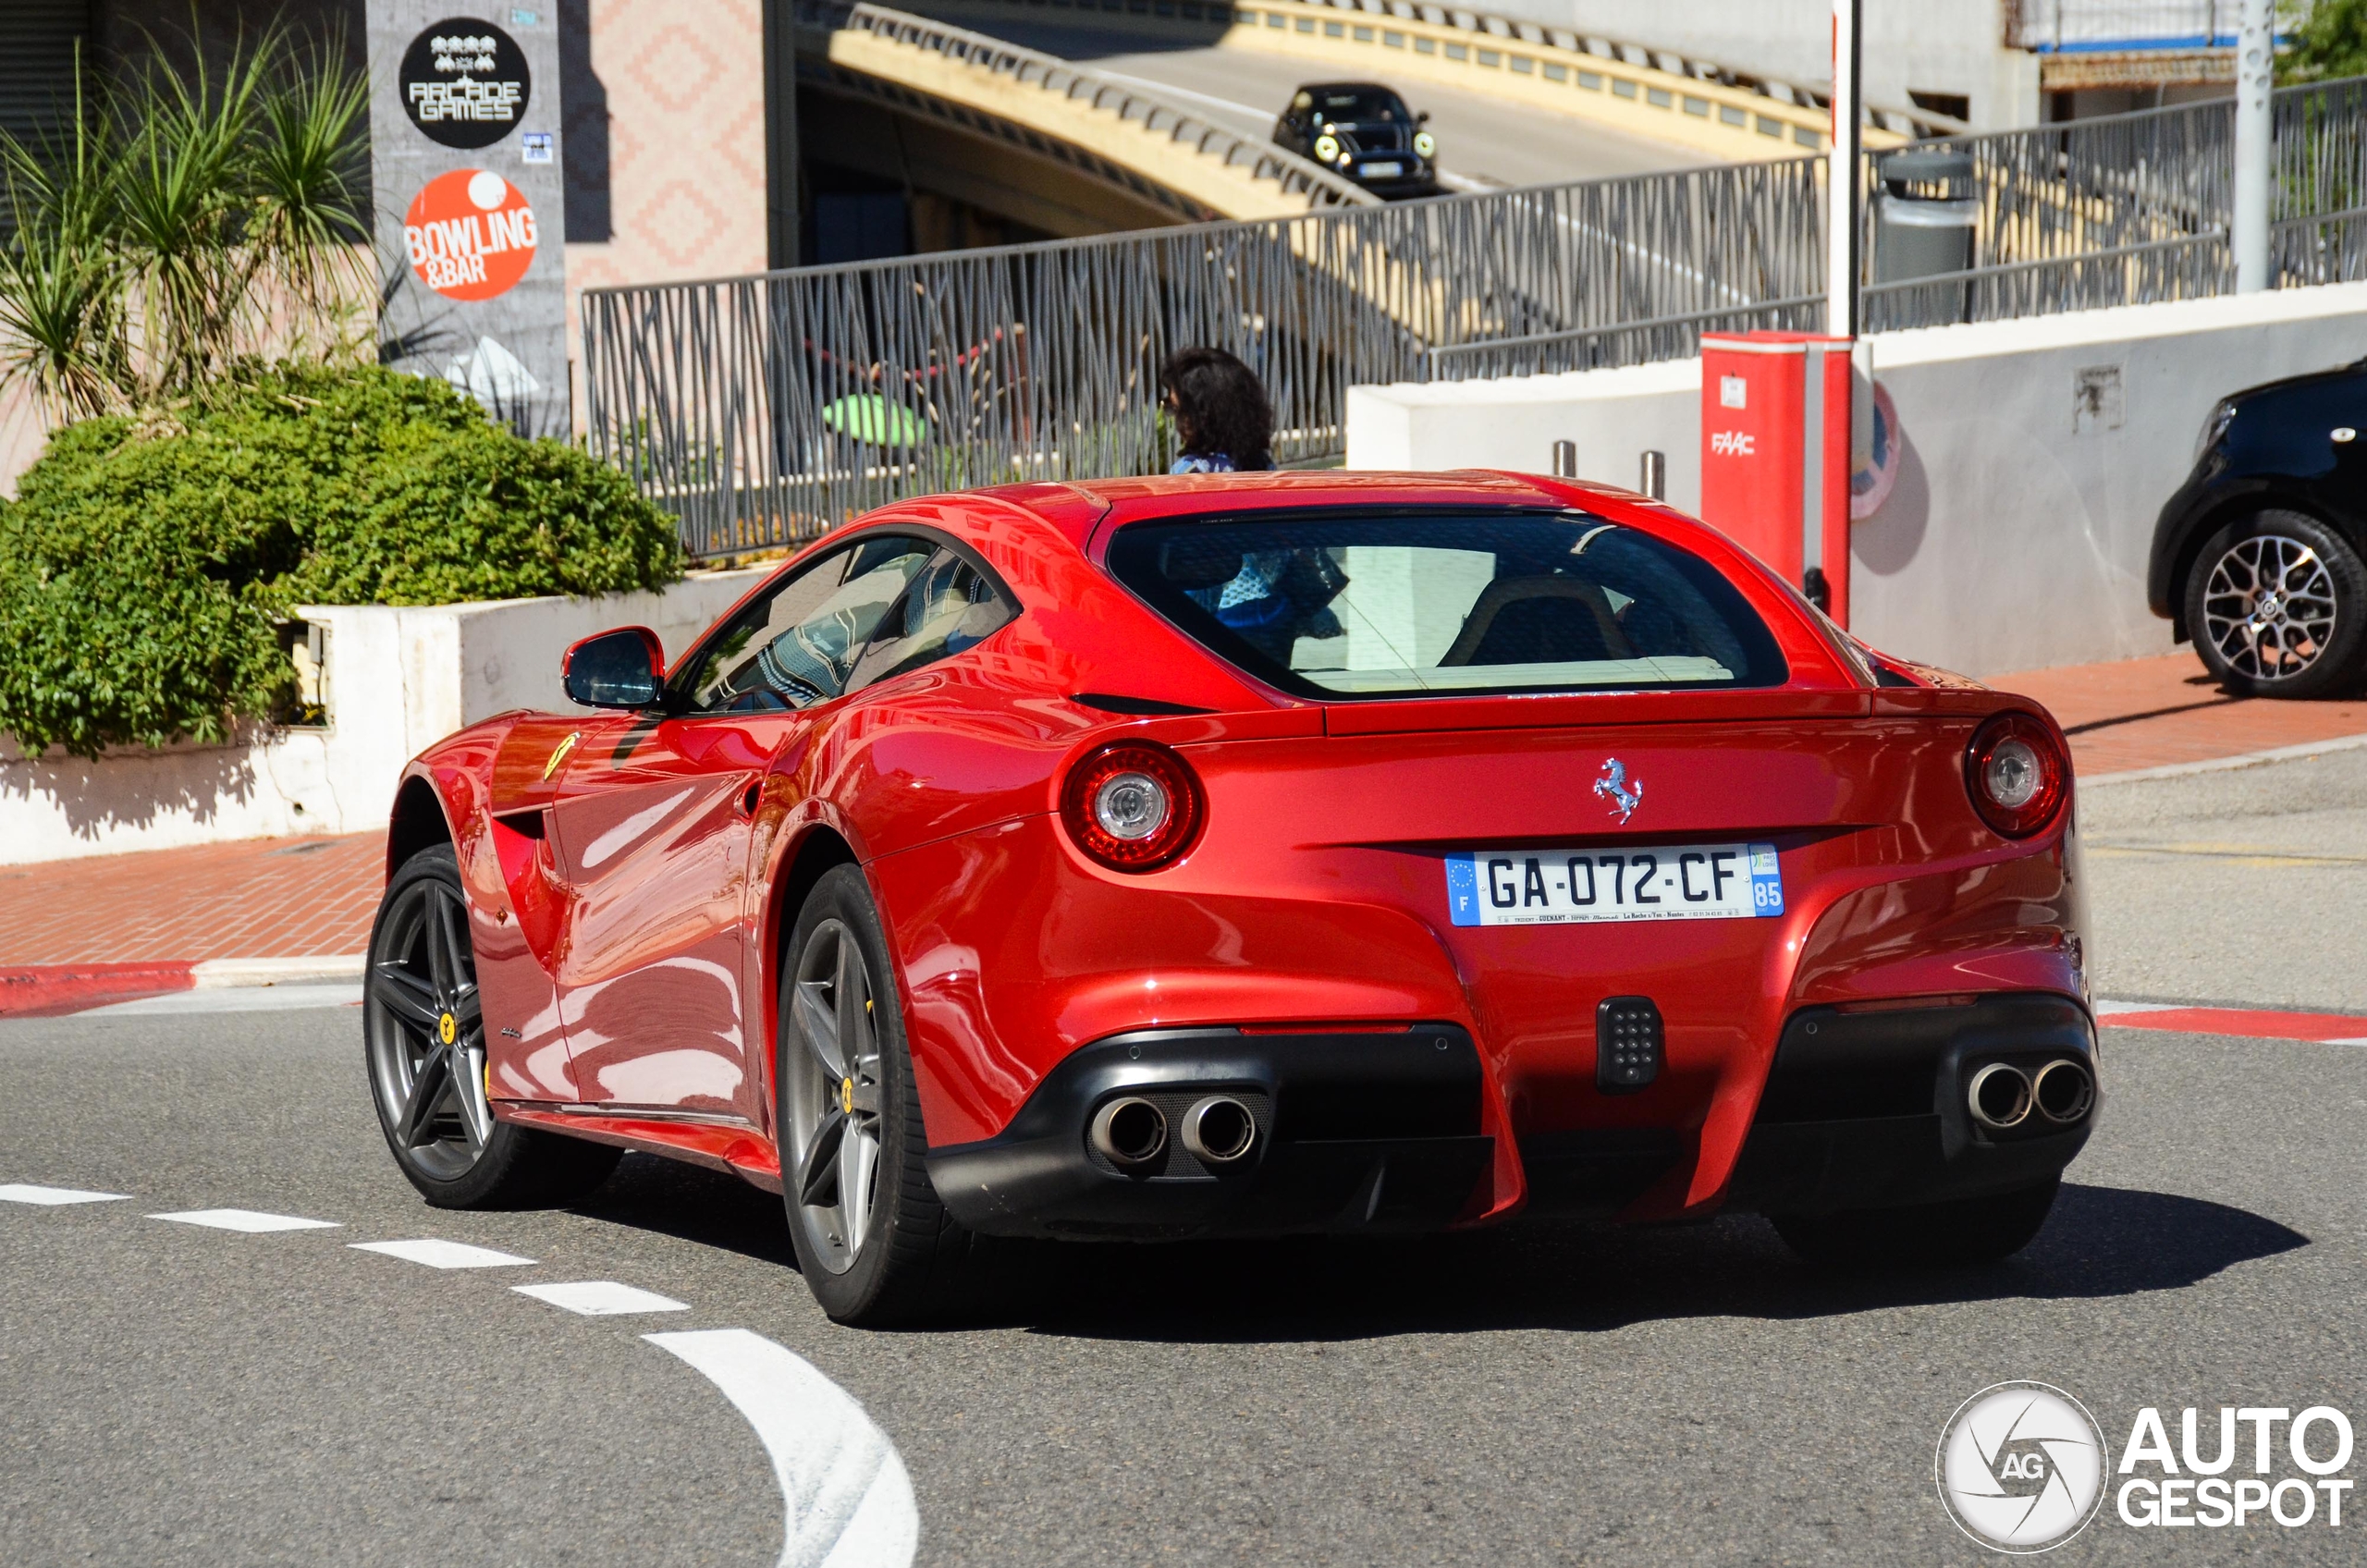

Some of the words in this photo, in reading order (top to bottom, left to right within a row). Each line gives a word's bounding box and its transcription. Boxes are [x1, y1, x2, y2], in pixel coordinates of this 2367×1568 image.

[409, 81, 521, 104] ARCADE
[419, 99, 514, 121] GAMES
[403, 206, 538, 265] BOWLING
[425, 253, 488, 290] &BAR
[1711, 430, 1755, 457] FAAC
[1488, 851, 1736, 908] GA-072-CF
[1459, 896, 1468, 912] F
[1754, 882, 1782, 907] 85
